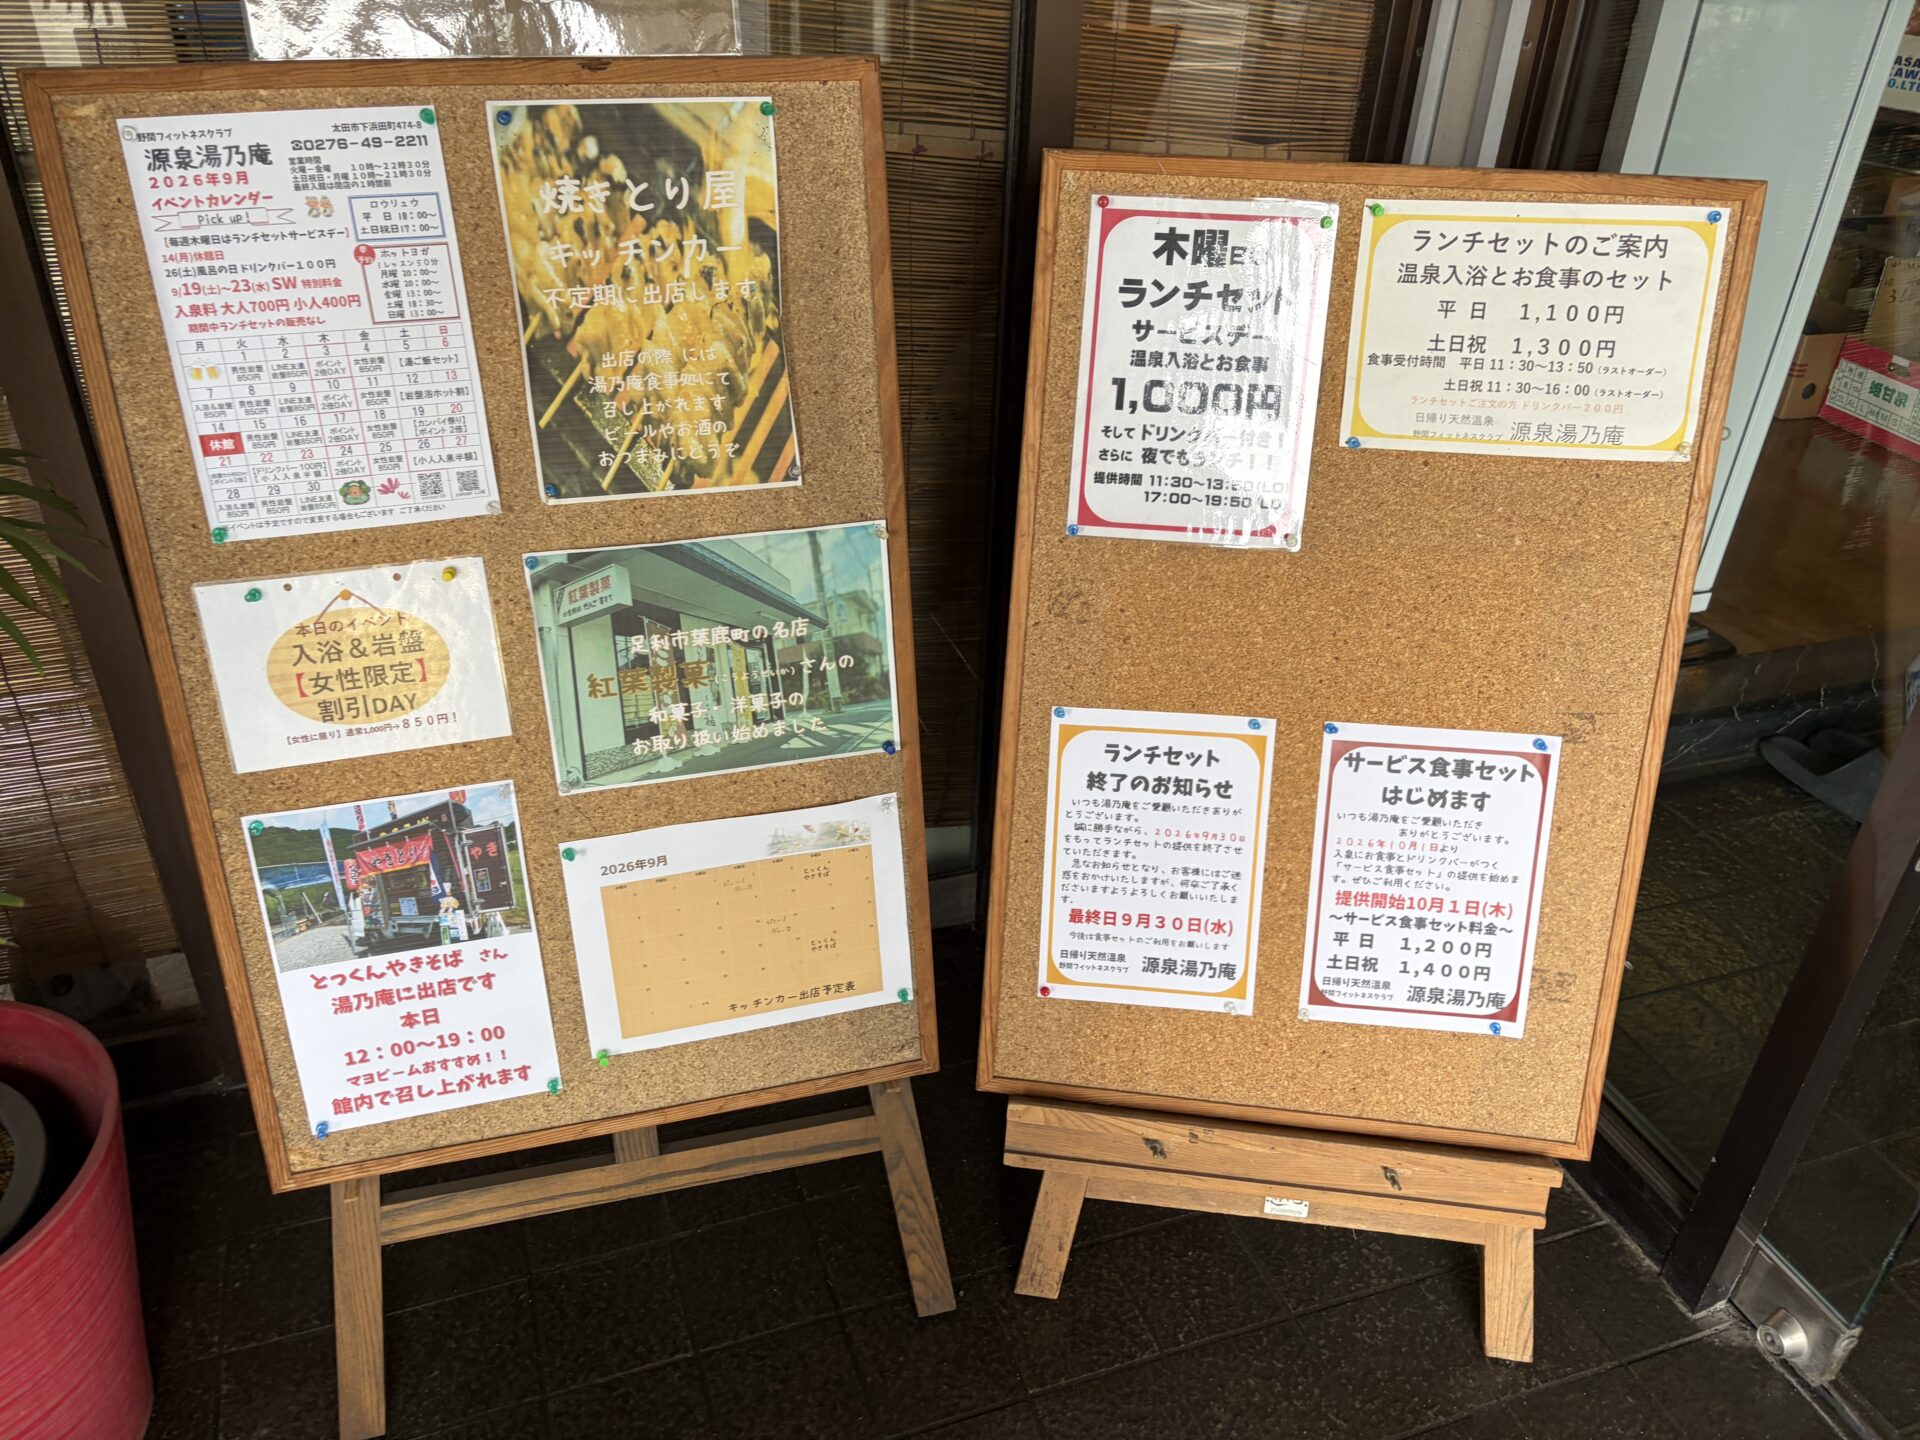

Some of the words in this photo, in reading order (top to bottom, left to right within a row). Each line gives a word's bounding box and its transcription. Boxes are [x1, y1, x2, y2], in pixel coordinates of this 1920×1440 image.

[144, 143, 273, 172] 源泉湯乃庵
[149, 171, 249, 189] 2026年9月
[540, 170, 740, 214] 焼きとり屋
[152, 191, 273, 210] イベントカレンダー
[370, 199, 419, 208] ロウリュウ
[198, 213, 223, 224] Pick
[230, 212, 249, 224] up!
[381, 247, 429, 257] ホットヨガ
[548, 235, 742, 278] キッチンカー
[1153, 227, 1266, 268] 木曜日
[1412, 229, 1669, 260] ランチセットのご案内
[272, 277, 297, 289] SW
[1397, 263, 1673, 292] 温泉入浴とお食事のセット
[221, 299, 289, 315] 大人700円
[294, 295, 361, 310] 小人400円
[543, 280, 756, 310] 不定期に出店します
[1520, 303, 1624, 325] 1,100円
[196, 342, 205, 351] 月
[236, 339, 247, 349] 火
[278, 336, 288, 346] 水
[319, 333, 329, 343] 木
[359, 330, 370, 340] 金
[399, 328, 410, 338] 土
[440, 325, 448, 334] 日
[1427, 334, 1486, 354] 土日祝
[1512, 336, 1615, 358] 1,300円
[1130, 350, 1269, 373] 温泉入浴とお食事
[1367, 353, 1445, 370] 食事受付時間
[1460, 356, 1484, 370] 平日
[589, 371, 730, 393] 湯乃庵食事処にて
[1443, 378, 1483, 392] 土日祝
[603, 394, 726, 418] 召し上がれます
[604, 420, 728, 441] ビールやお酒の
[1415, 411, 1493, 426] 日帰り天然温泉
[1101, 425, 1134, 440] そして
[1510, 421, 1625, 446] 源泉湯乃庵
[220, 457, 231, 466] 21
[260, 453, 273, 462] 22
[301, 449, 313, 459] 23
[340, 446, 353, 455] 24
[380, 442, 392, 452] 25
[418, 439, 430, 448] 26
[456, 436, 467, 445] 27
[598, 442, 740, 467] おつまみにどうぞ
[1098, 449, 1132, 462] さらに
[227, 489, 240, 499] 28
[267, 485, 280, 495] 29
[307, 482, 320, 491] 30
[1094, 471, 1143, 486] 提供時間
[296, 614, 406, 638] 本日のイベント
[630, 617, 810, 655] 足利市葉鹿町の名店
[296, 658, 428, 697] 【女性限定】
[587, 660, 712, 700] 紅葉製菓
[318, 693, 416, 723] 割引DAY
[632, 717, 826, 756] お取り扱い始めました
[1104, 743, 1220, 768] ランチセット
[1344, 752, 1535, 783] サービス食事セット
[1086, 771, 1233, 799] 終了のお知らせ
[1382, 786, 1491, 812] はじめます
[1065, 810, 1141, 823] とうございます。
[1399, 829, 1511, 845] ありがとうございます。
[600, 855, 668, 876] 2026年9月
[1064, 848, 1138, 860] ていただきます。
[1060, 895, 1074, 904] す。
[1335, 891, 1513, 920] 提供開始10月1日(木)
[1068, 909, 1234, 936] 最終日9月30日(水)
[1060, 950, 1127, 962] 日帰り天然温泉
[1400, 937, 1492, 958] 1,200円
[310, 950, 464, 990] とっくんやきそば
[479, 948, 509, 962] さん
[1141, 956, 1237, 980] 源泉湯乃庵
[1326, 955, 1378, 973] 土日祝
[1399, 961, 1491, 981] 1,400円
[331, 972, 496, 1015] 湯乃庵に出店です
[1321, 977, 1392, 990] 日帰り天然温泉
[729, 980, 856, 1012] キッチンカー出店予定表
[1407, 985, 1506, 1010] 源泉湯乃庵
[400, 1008, 440, 1028] 本日
[332, 1065, 531, 1115] 館内で召し上がれます
